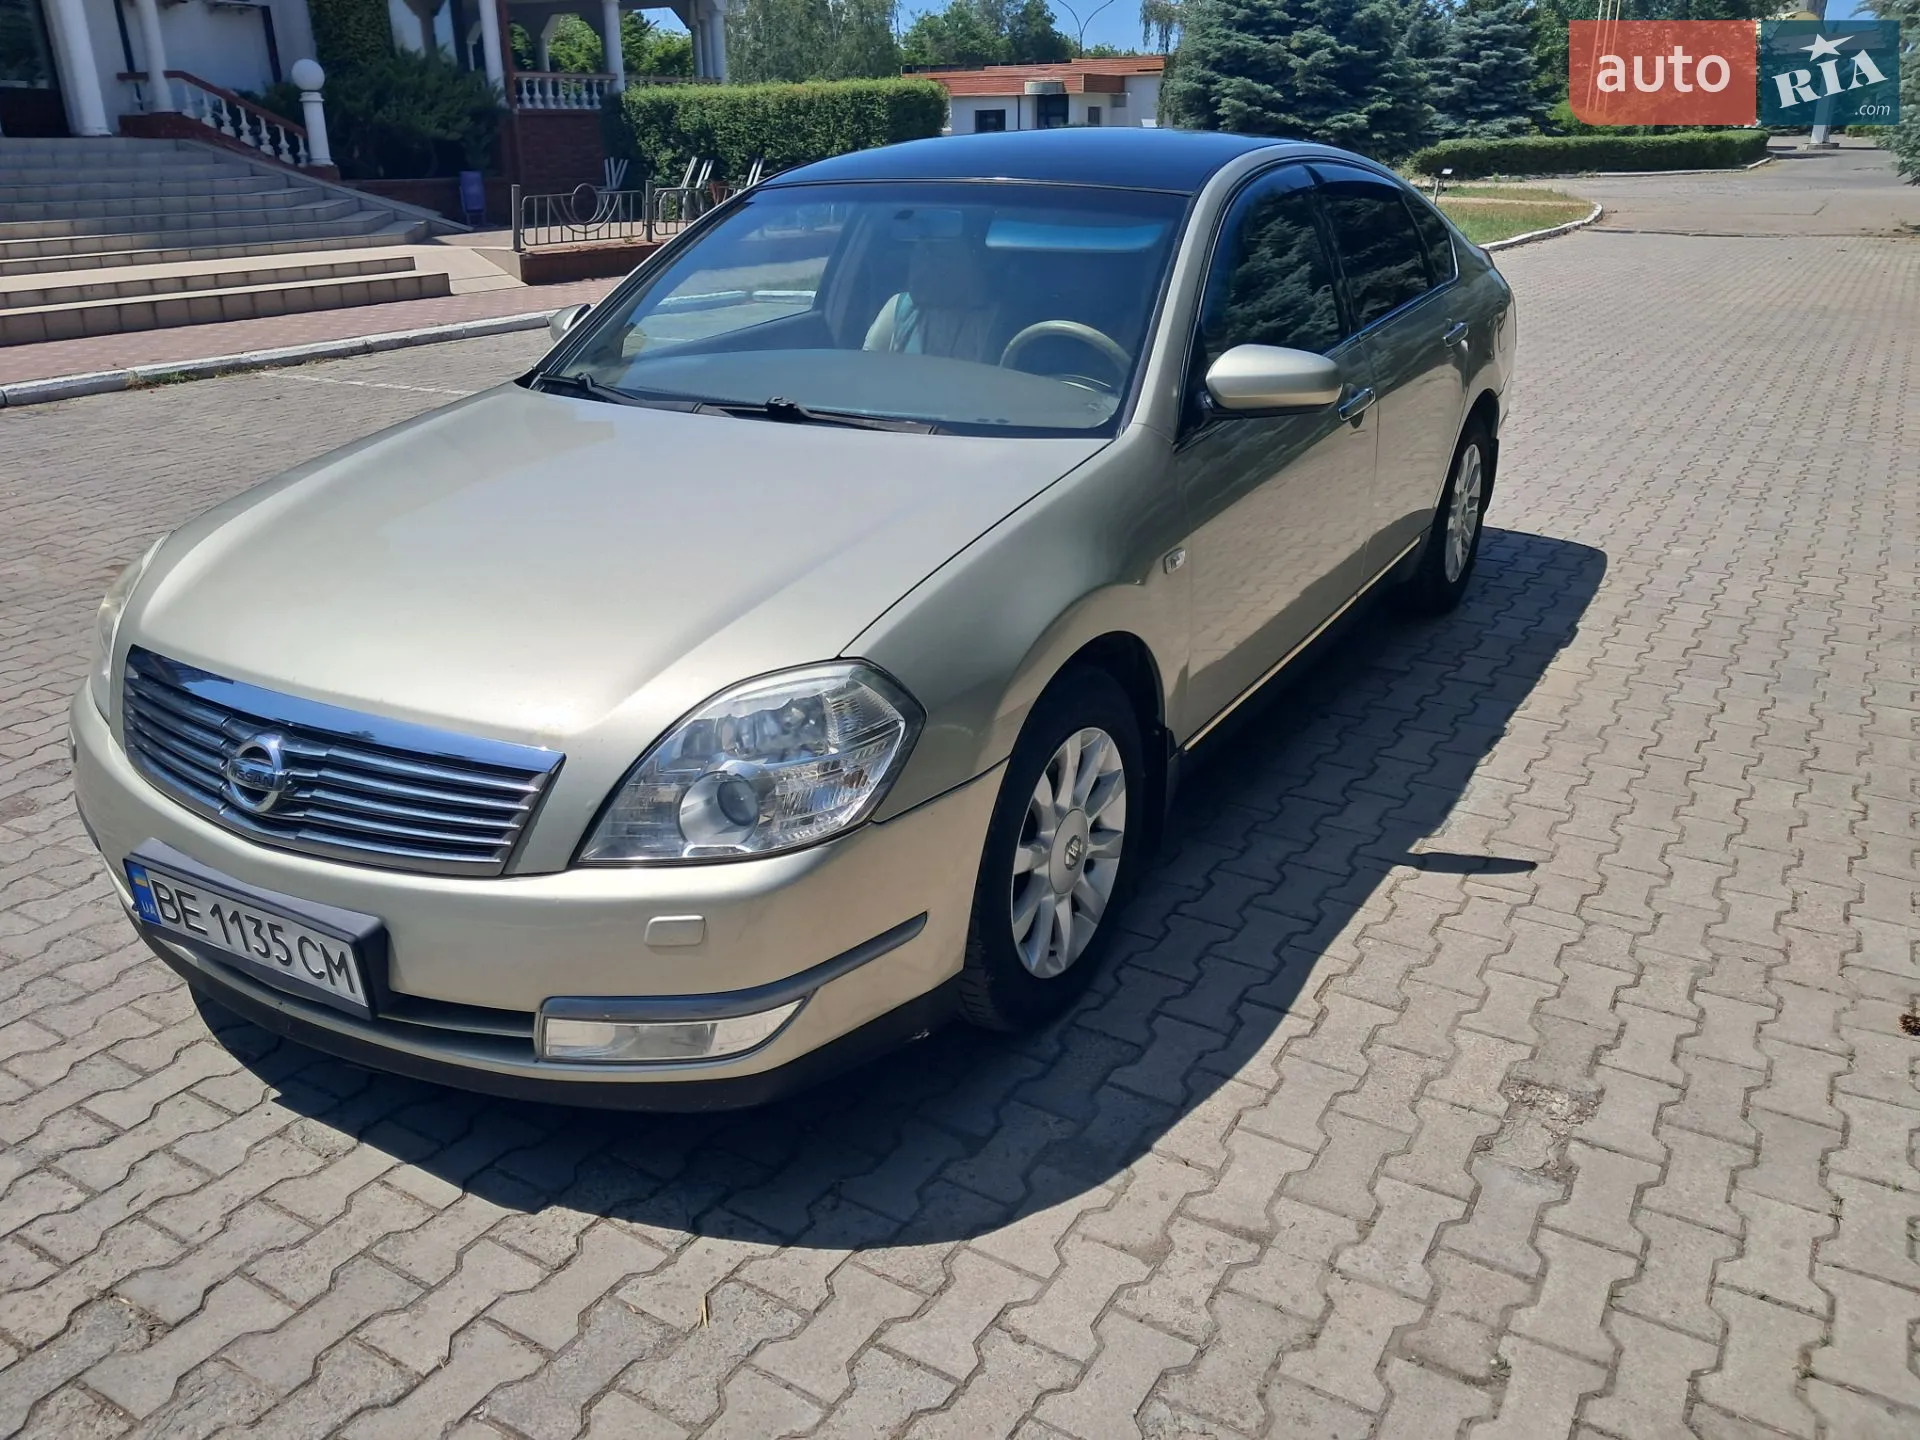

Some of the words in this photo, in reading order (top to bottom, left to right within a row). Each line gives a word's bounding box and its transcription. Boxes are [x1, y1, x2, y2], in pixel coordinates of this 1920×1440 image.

[151, 879, 208, 936] BE
[210, 903, 293, 967] 1135
[297, 935, 356, 994] CM
